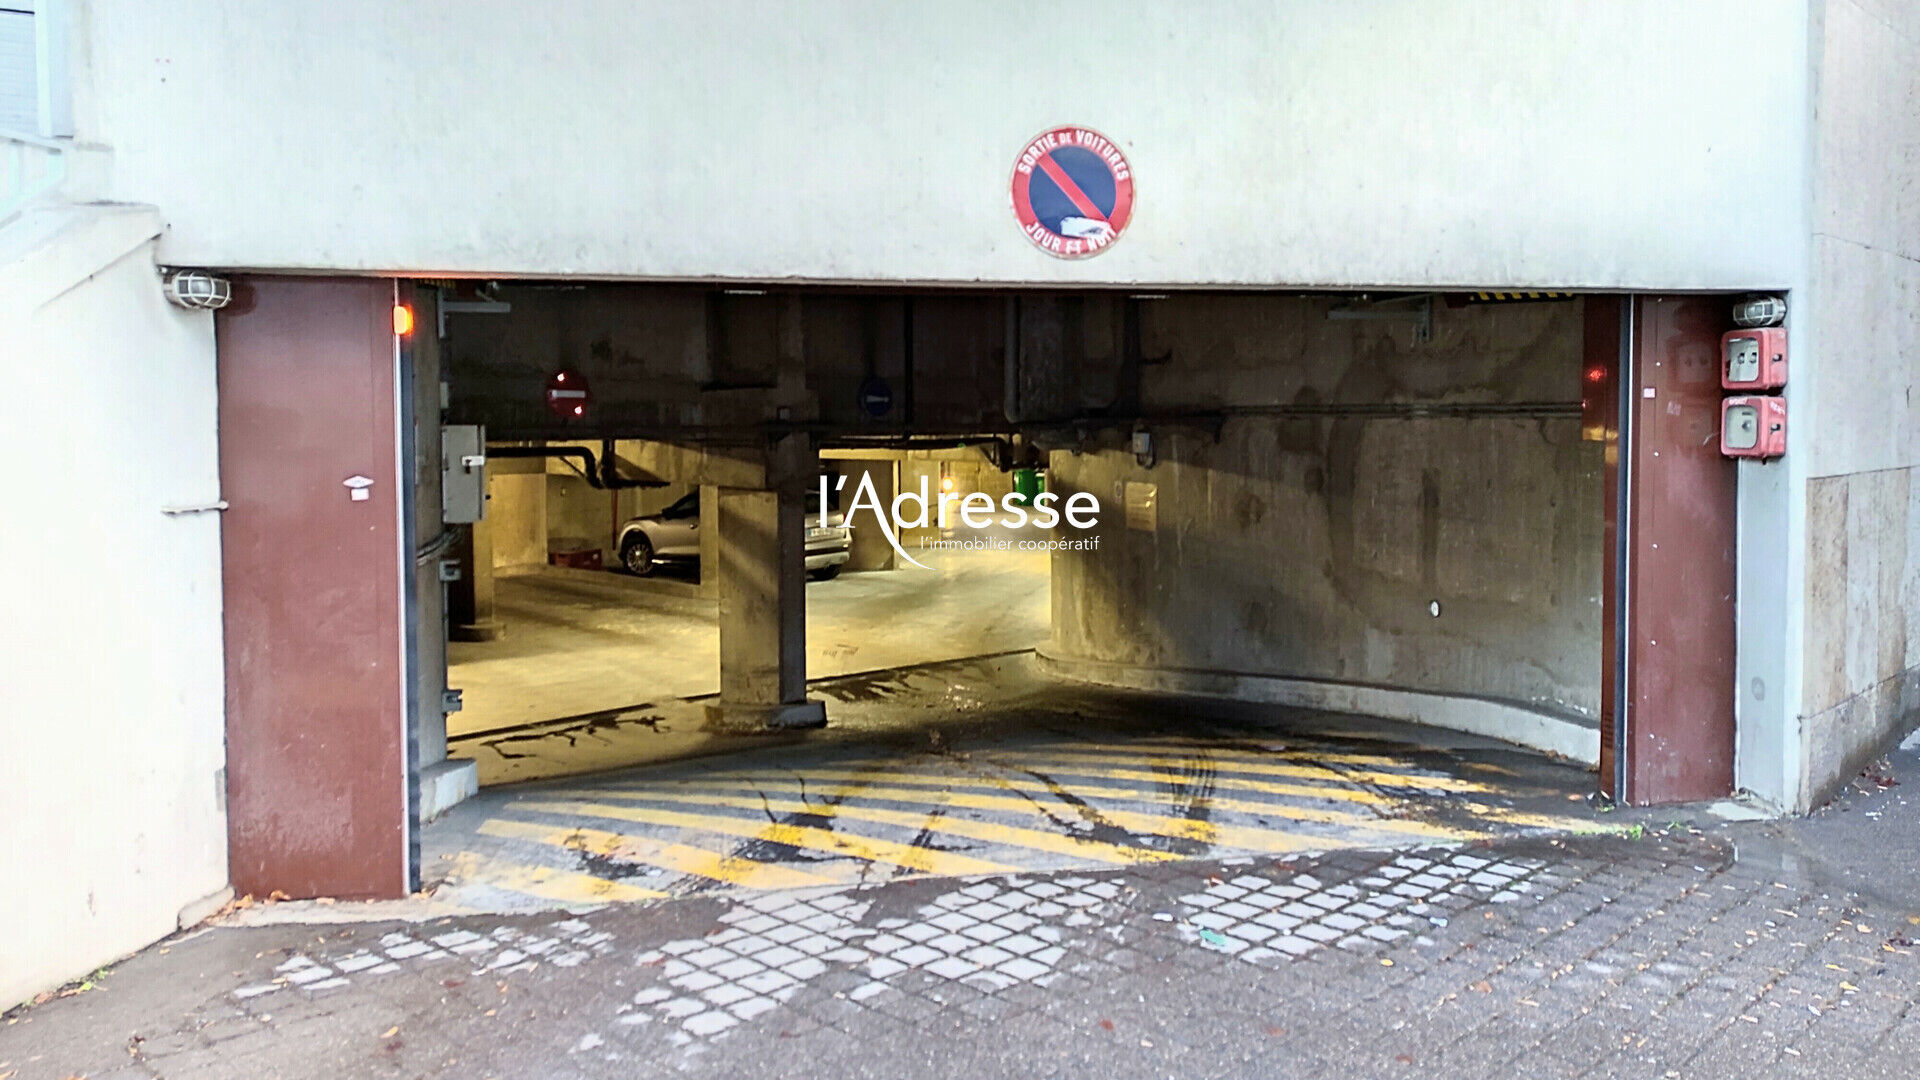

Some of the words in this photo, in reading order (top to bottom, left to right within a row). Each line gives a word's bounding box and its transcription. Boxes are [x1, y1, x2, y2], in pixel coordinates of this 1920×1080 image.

[1017, 133, 1058, 174] SORTIE
[1075, 129, 1130, 181] VOITURES
[1025, 222, 1061, 252] JOUR
[1065, 240, 1082, 254] ET
